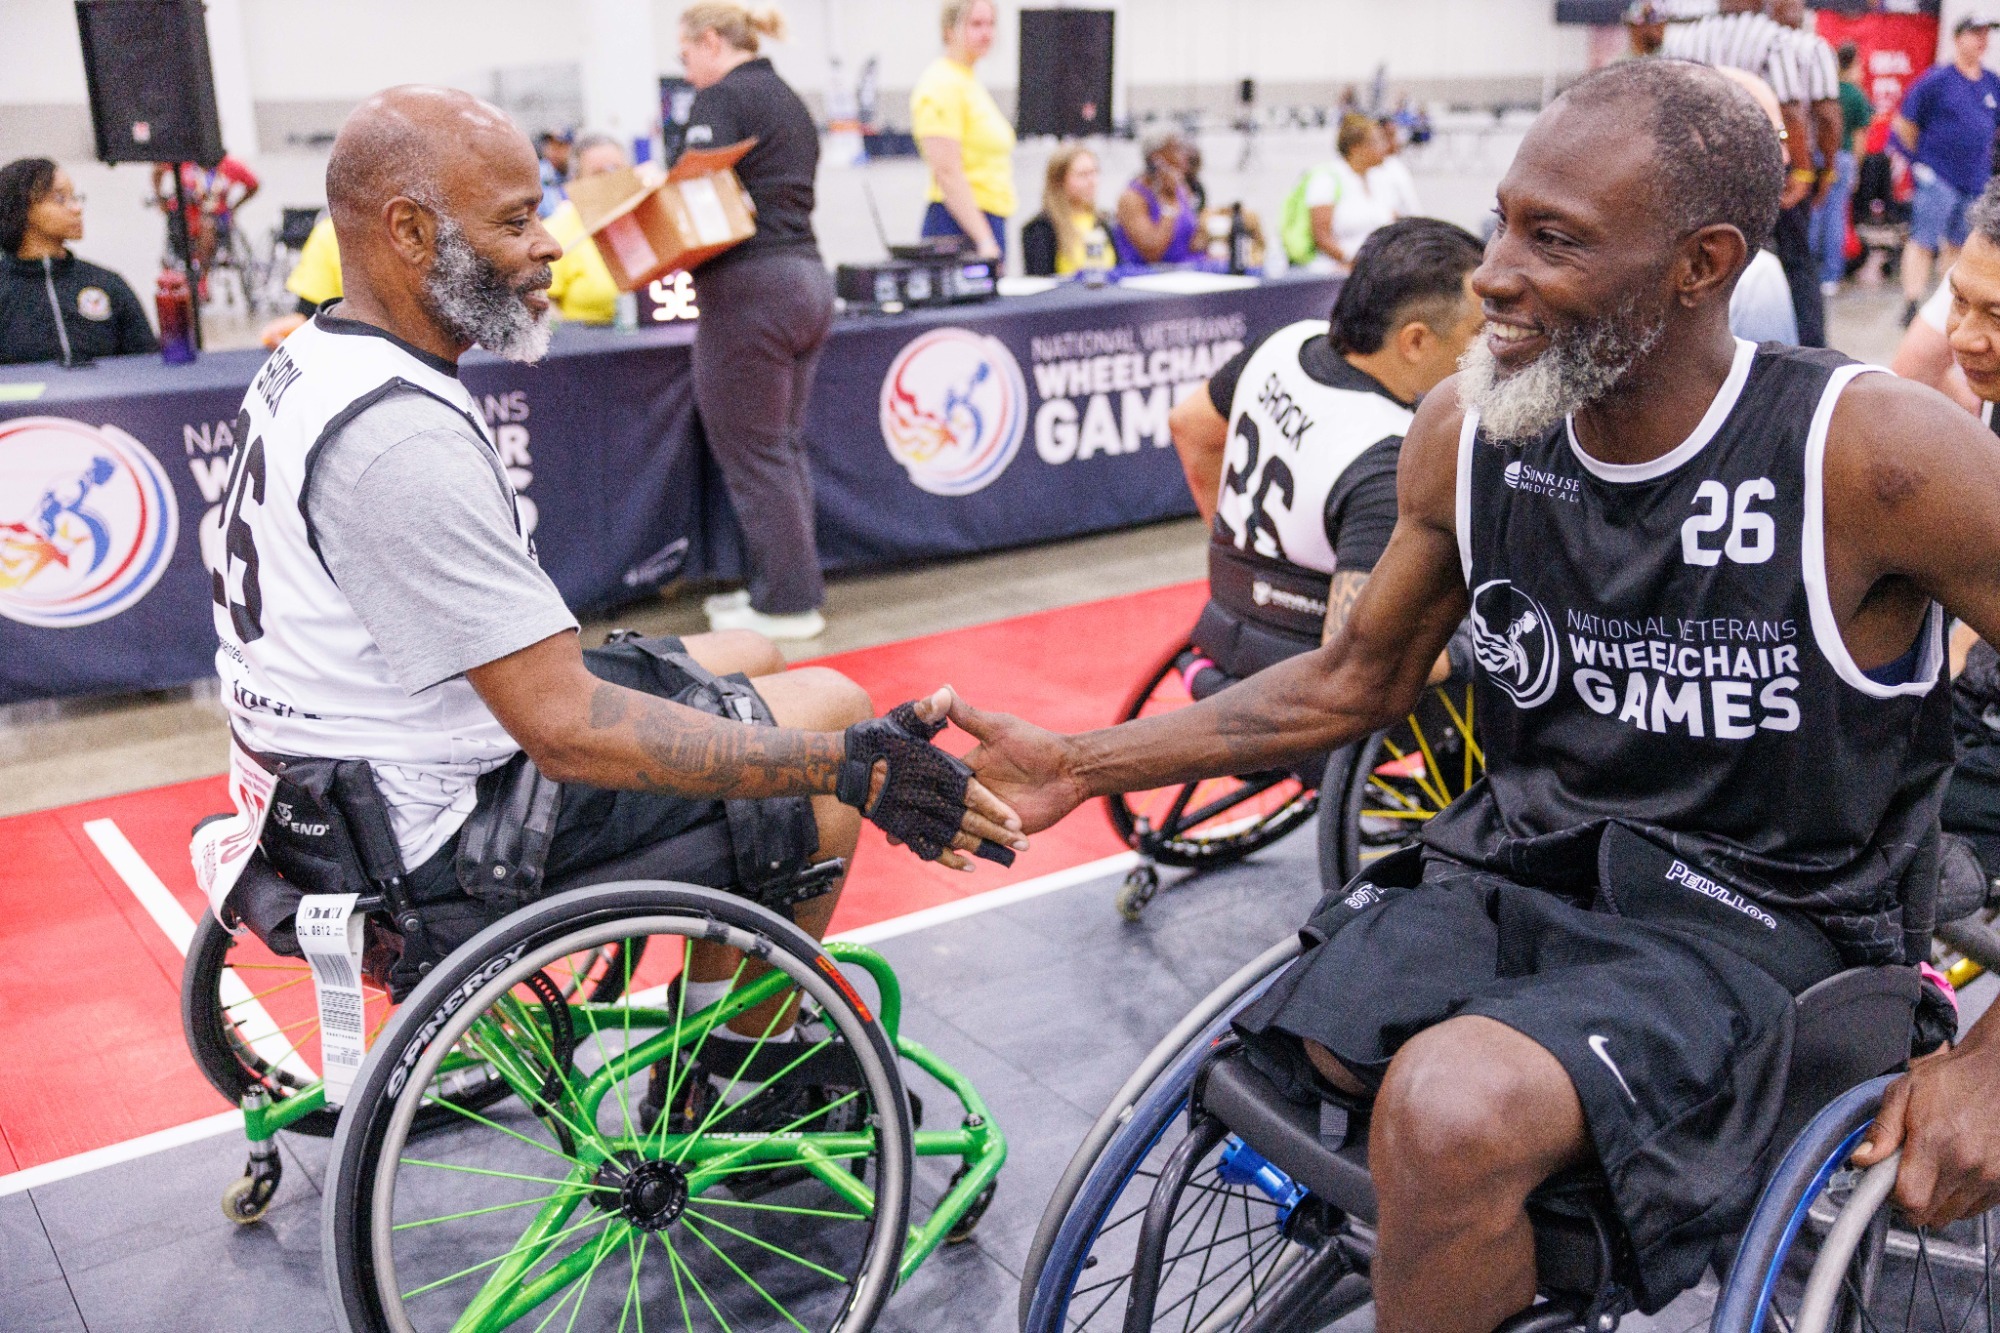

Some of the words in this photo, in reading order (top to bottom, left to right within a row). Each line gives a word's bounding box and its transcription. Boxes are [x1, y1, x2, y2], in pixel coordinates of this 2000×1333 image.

[1034, 381, 1206, 465] GAM
[1519, 481, 1576, 503] MEDICAL
[1521, 464, 1580, 493] SUNRISE
[1681, 477, 1776, 566] 26
[1568, 609, 1673, 639] NATIONAL
[1678, 617, 1797, 642] VETERANS
[1568, 633, 1800, 679] WHEELCHAIR
[1573, 667, 1800, 740] GAMES
[305, 907, 343, 919] DTW
[387, 940, 530, 1099] SPINERGY
